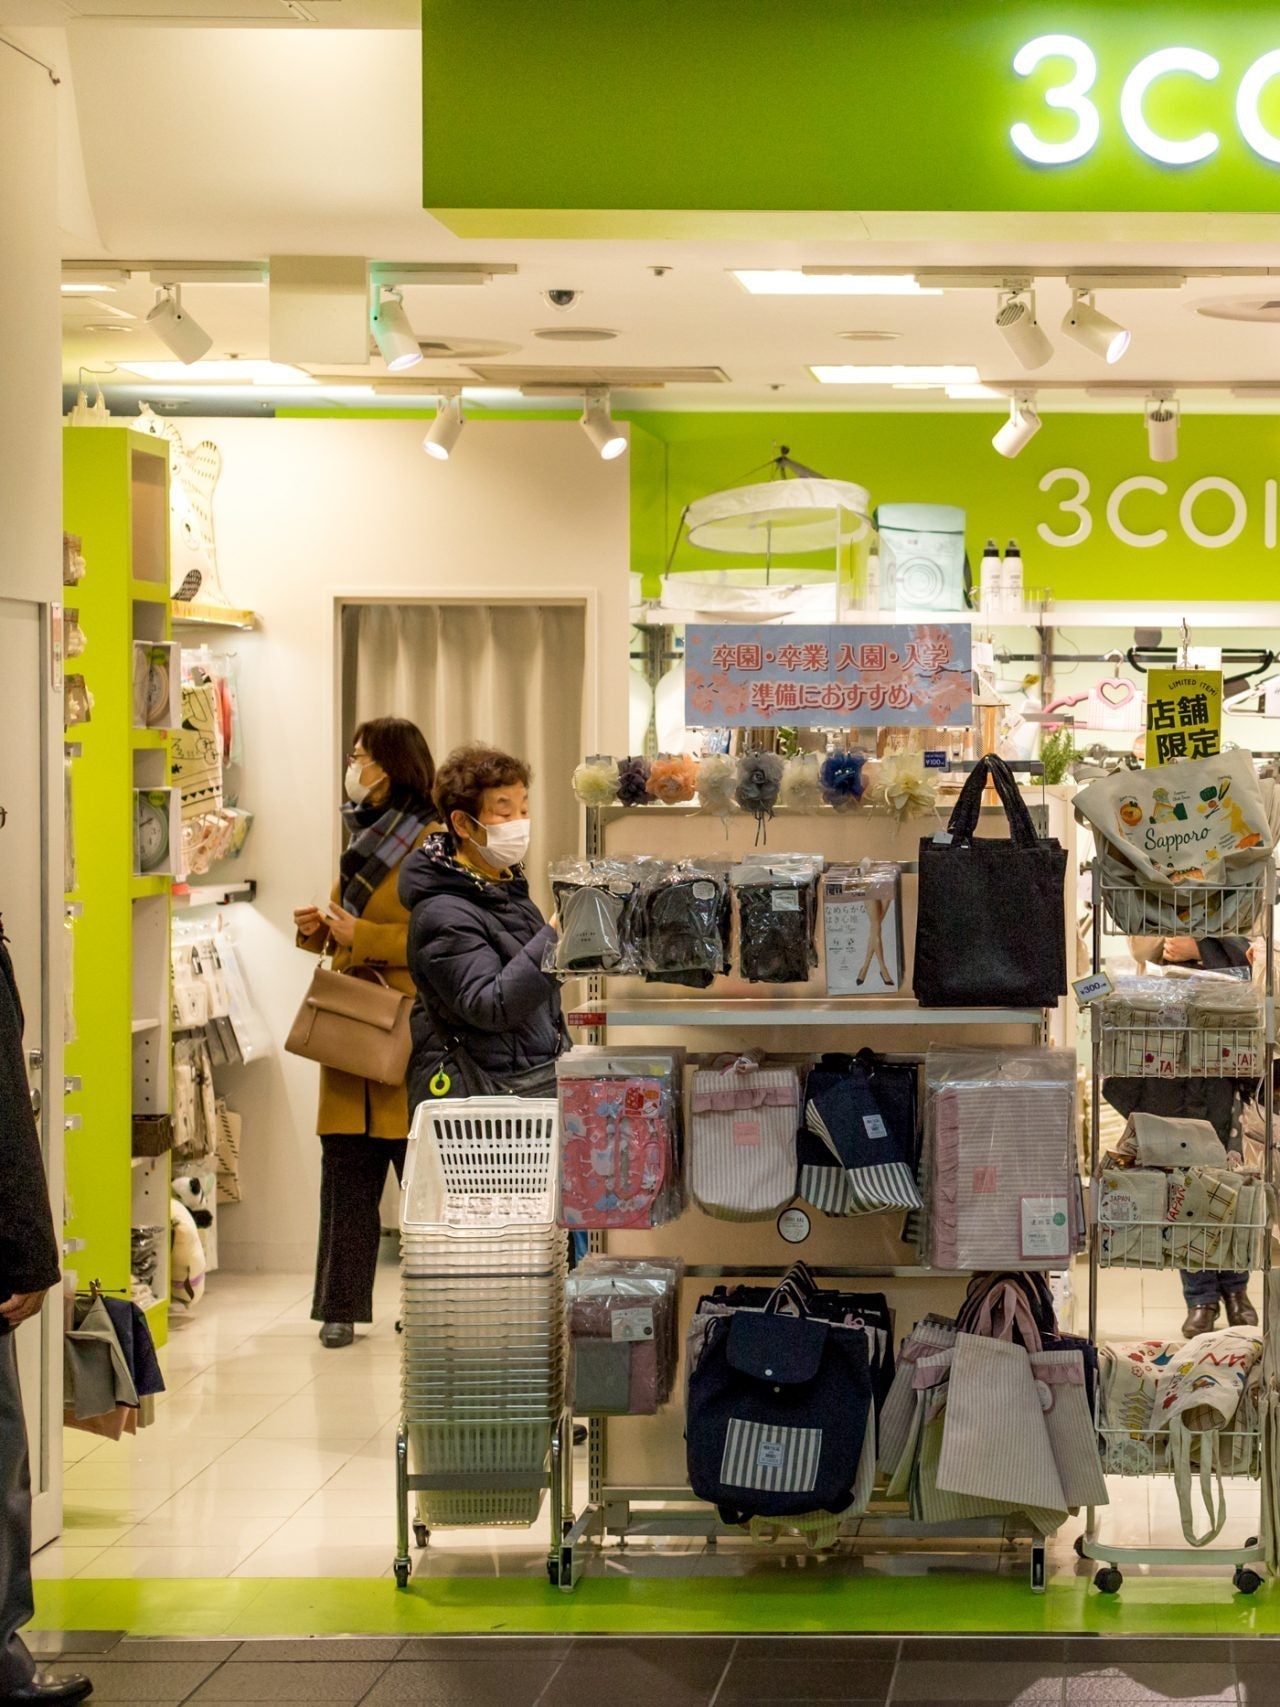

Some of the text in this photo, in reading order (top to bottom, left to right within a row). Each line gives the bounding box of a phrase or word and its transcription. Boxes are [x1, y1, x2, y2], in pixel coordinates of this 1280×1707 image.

[712, 643, 950, 671] 卒園・卒業 入園・入学
[751, 683, 913, 709] 準備におすすめ
[1168, 679, 1219, 697] LIMITED ITEM!
[1147, 693, 1209, 731] 店舗
[1156, 728, 1220, 764] 限定
[1144, 827, 1211, 852] Sapporo
